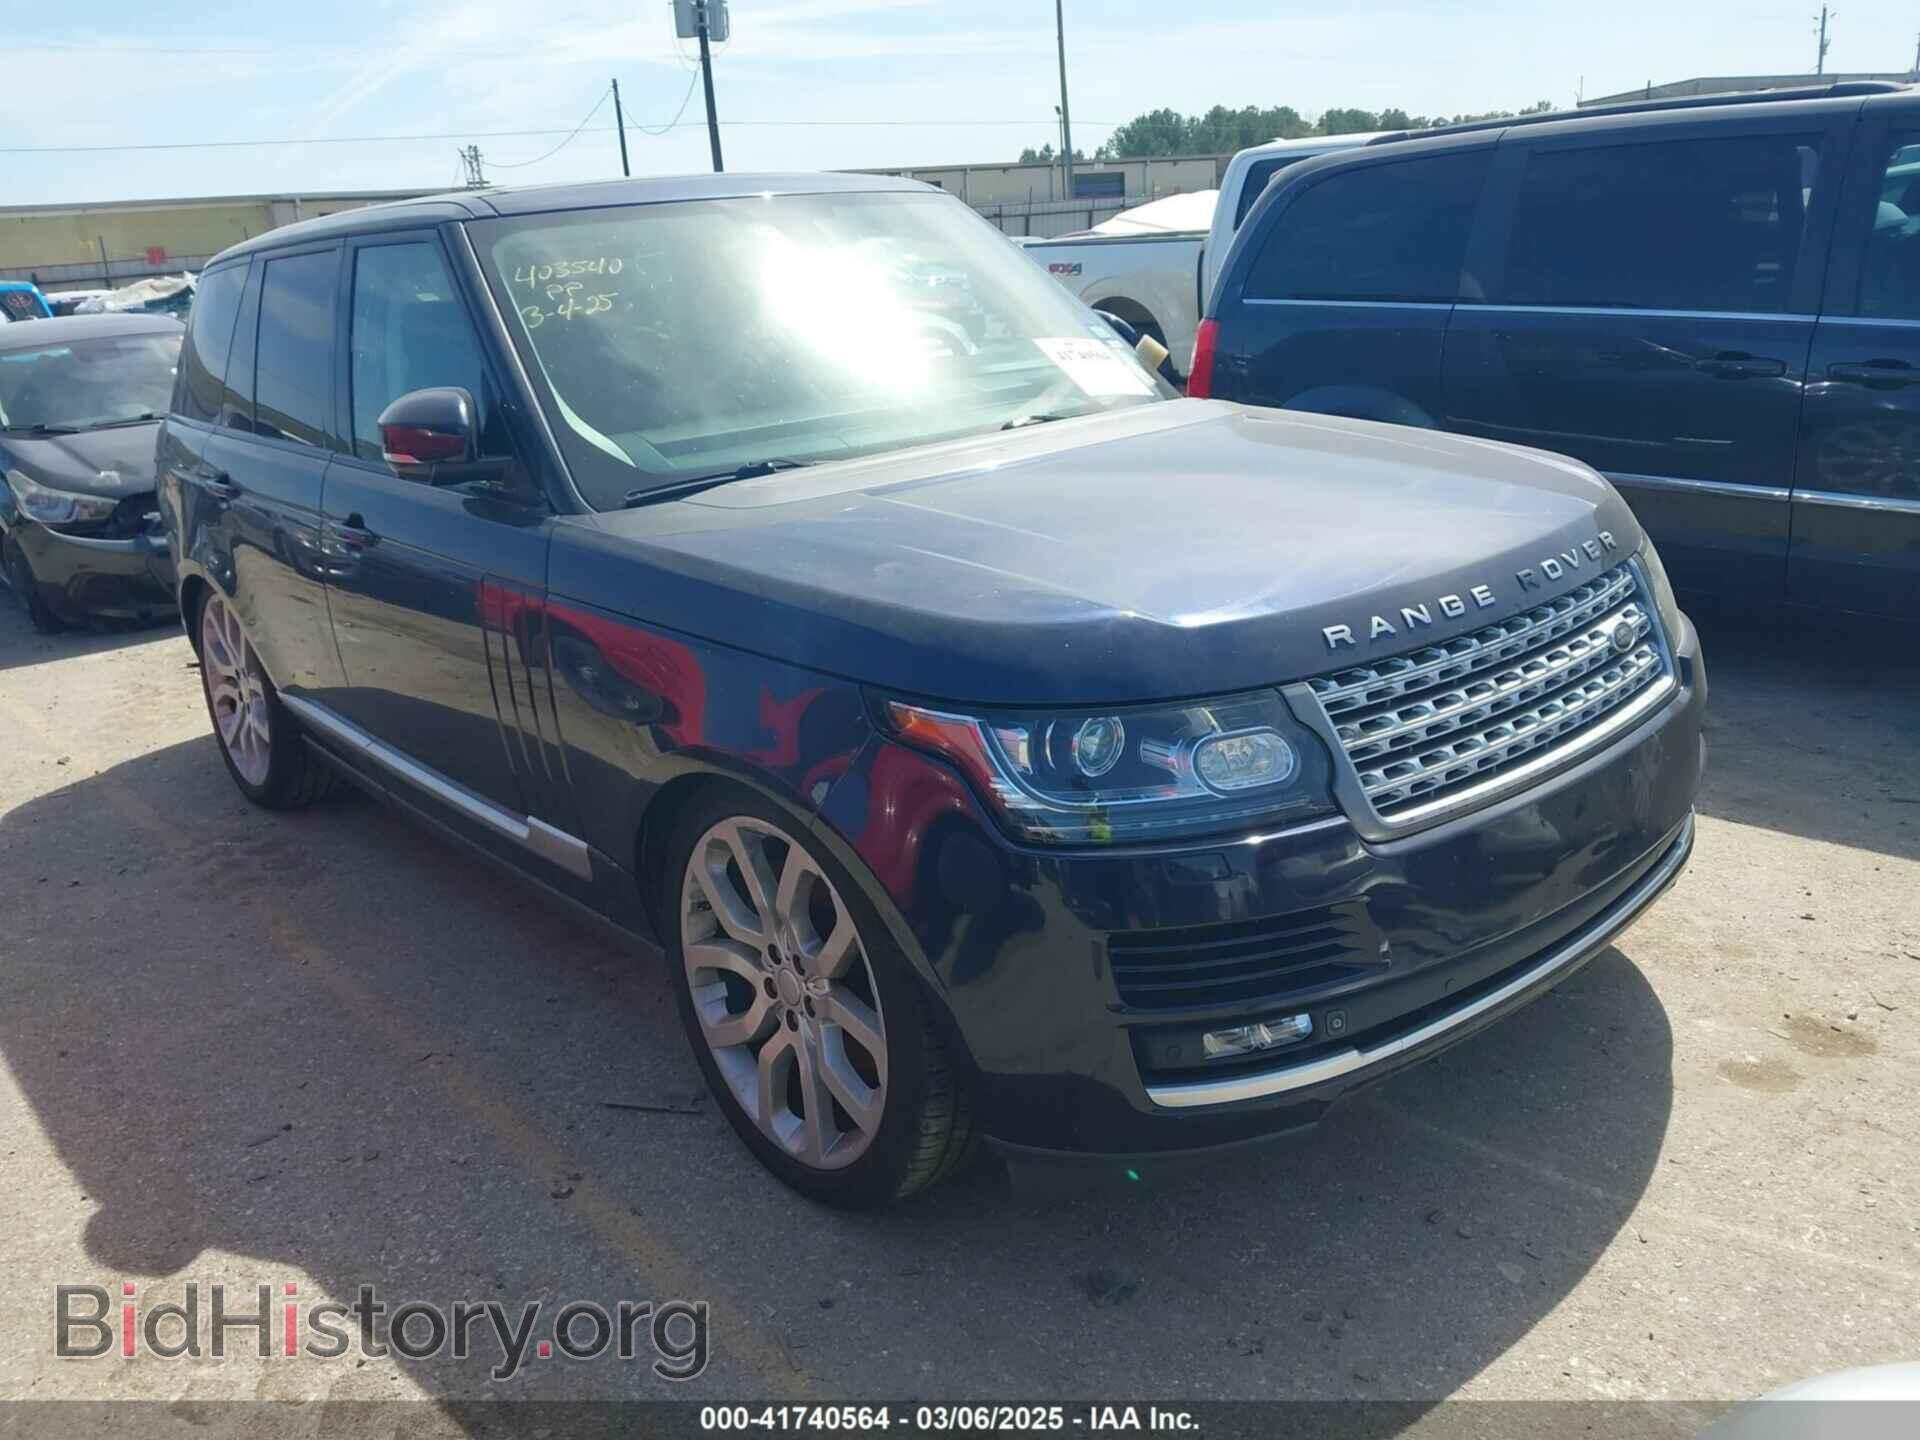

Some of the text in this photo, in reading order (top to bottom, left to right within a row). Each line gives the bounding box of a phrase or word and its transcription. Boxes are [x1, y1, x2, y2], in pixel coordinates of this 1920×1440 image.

[514, 257, 622, 288] 403540
[519, 292, 619, 329] 3-4-25
[1321, 530, 1618, 649] RANGE ROVER
